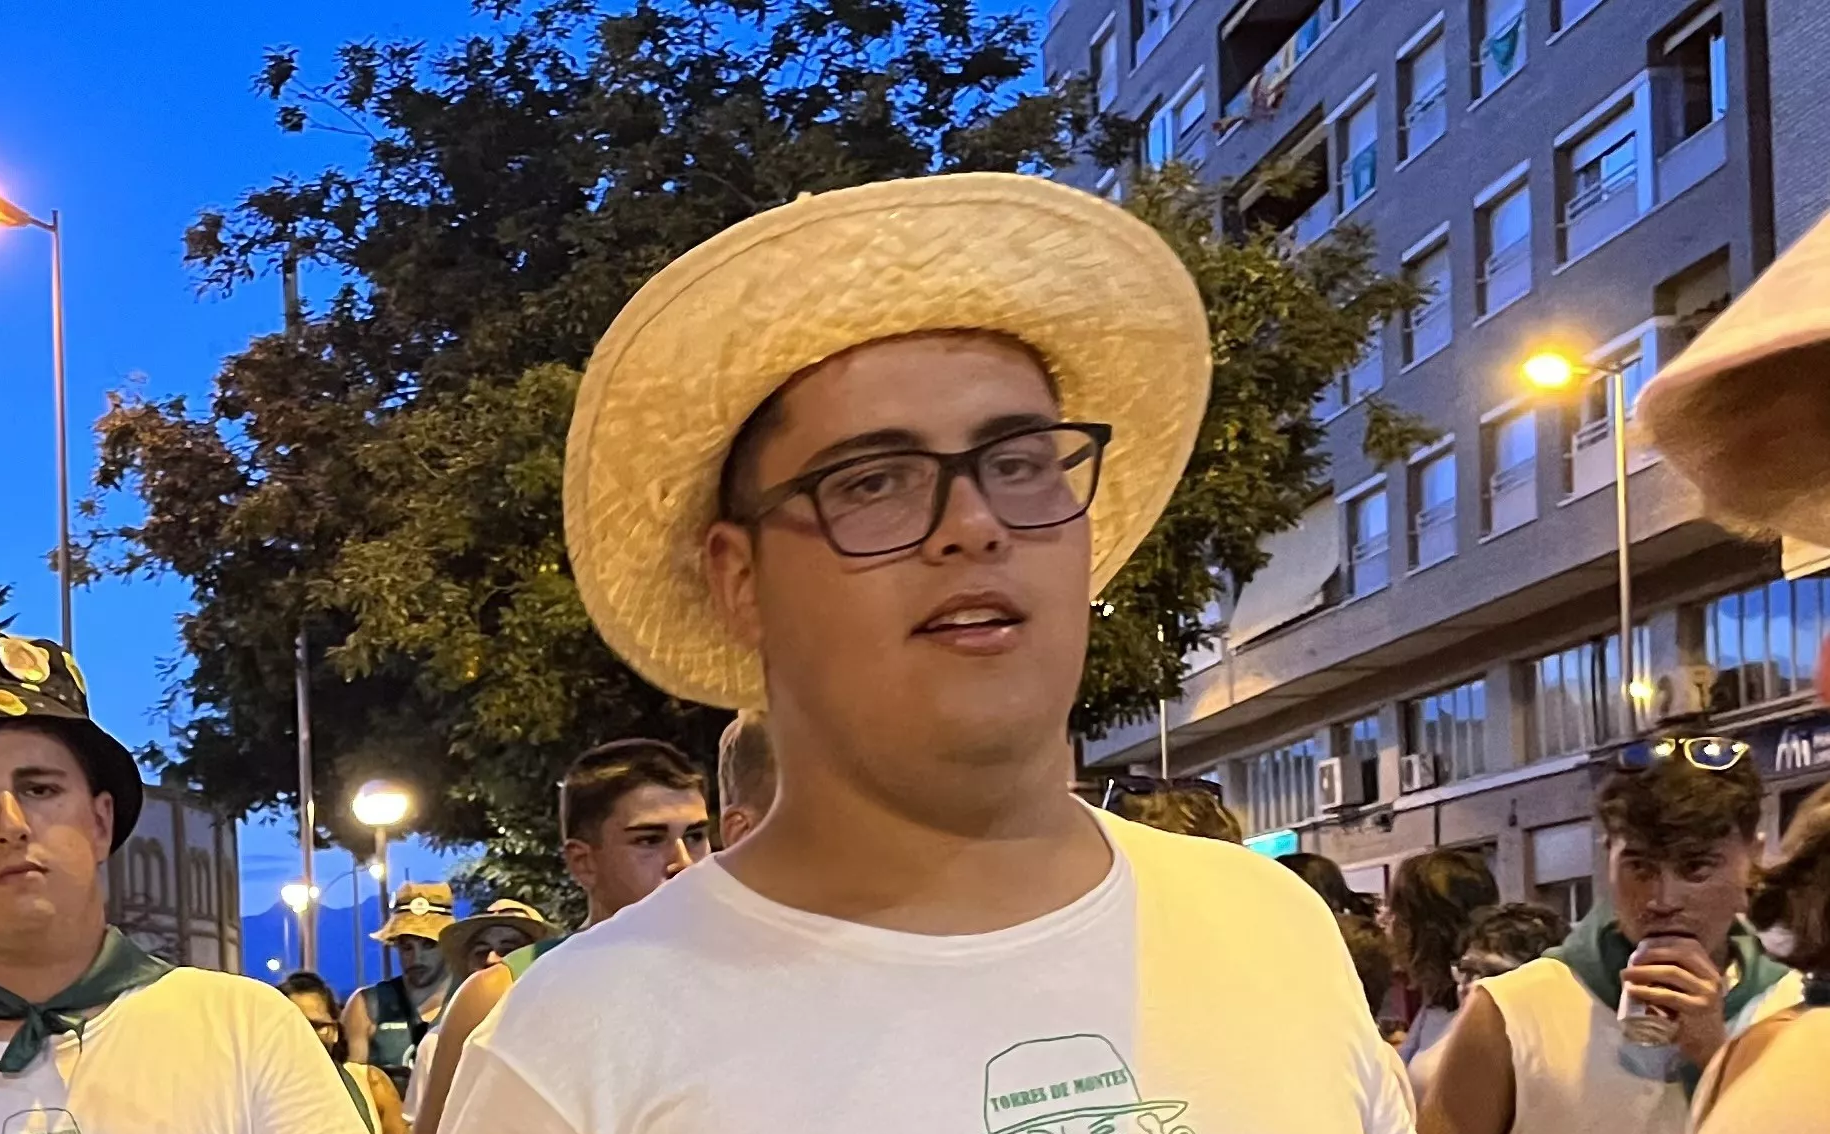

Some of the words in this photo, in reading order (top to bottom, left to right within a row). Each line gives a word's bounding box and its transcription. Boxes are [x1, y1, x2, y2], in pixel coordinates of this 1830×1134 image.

[990, 1087, 1047, 1112] TORRES
[1049, 1082, 1069, 1099] DE
[1073, 1068, 1128, 1094] MONTES
